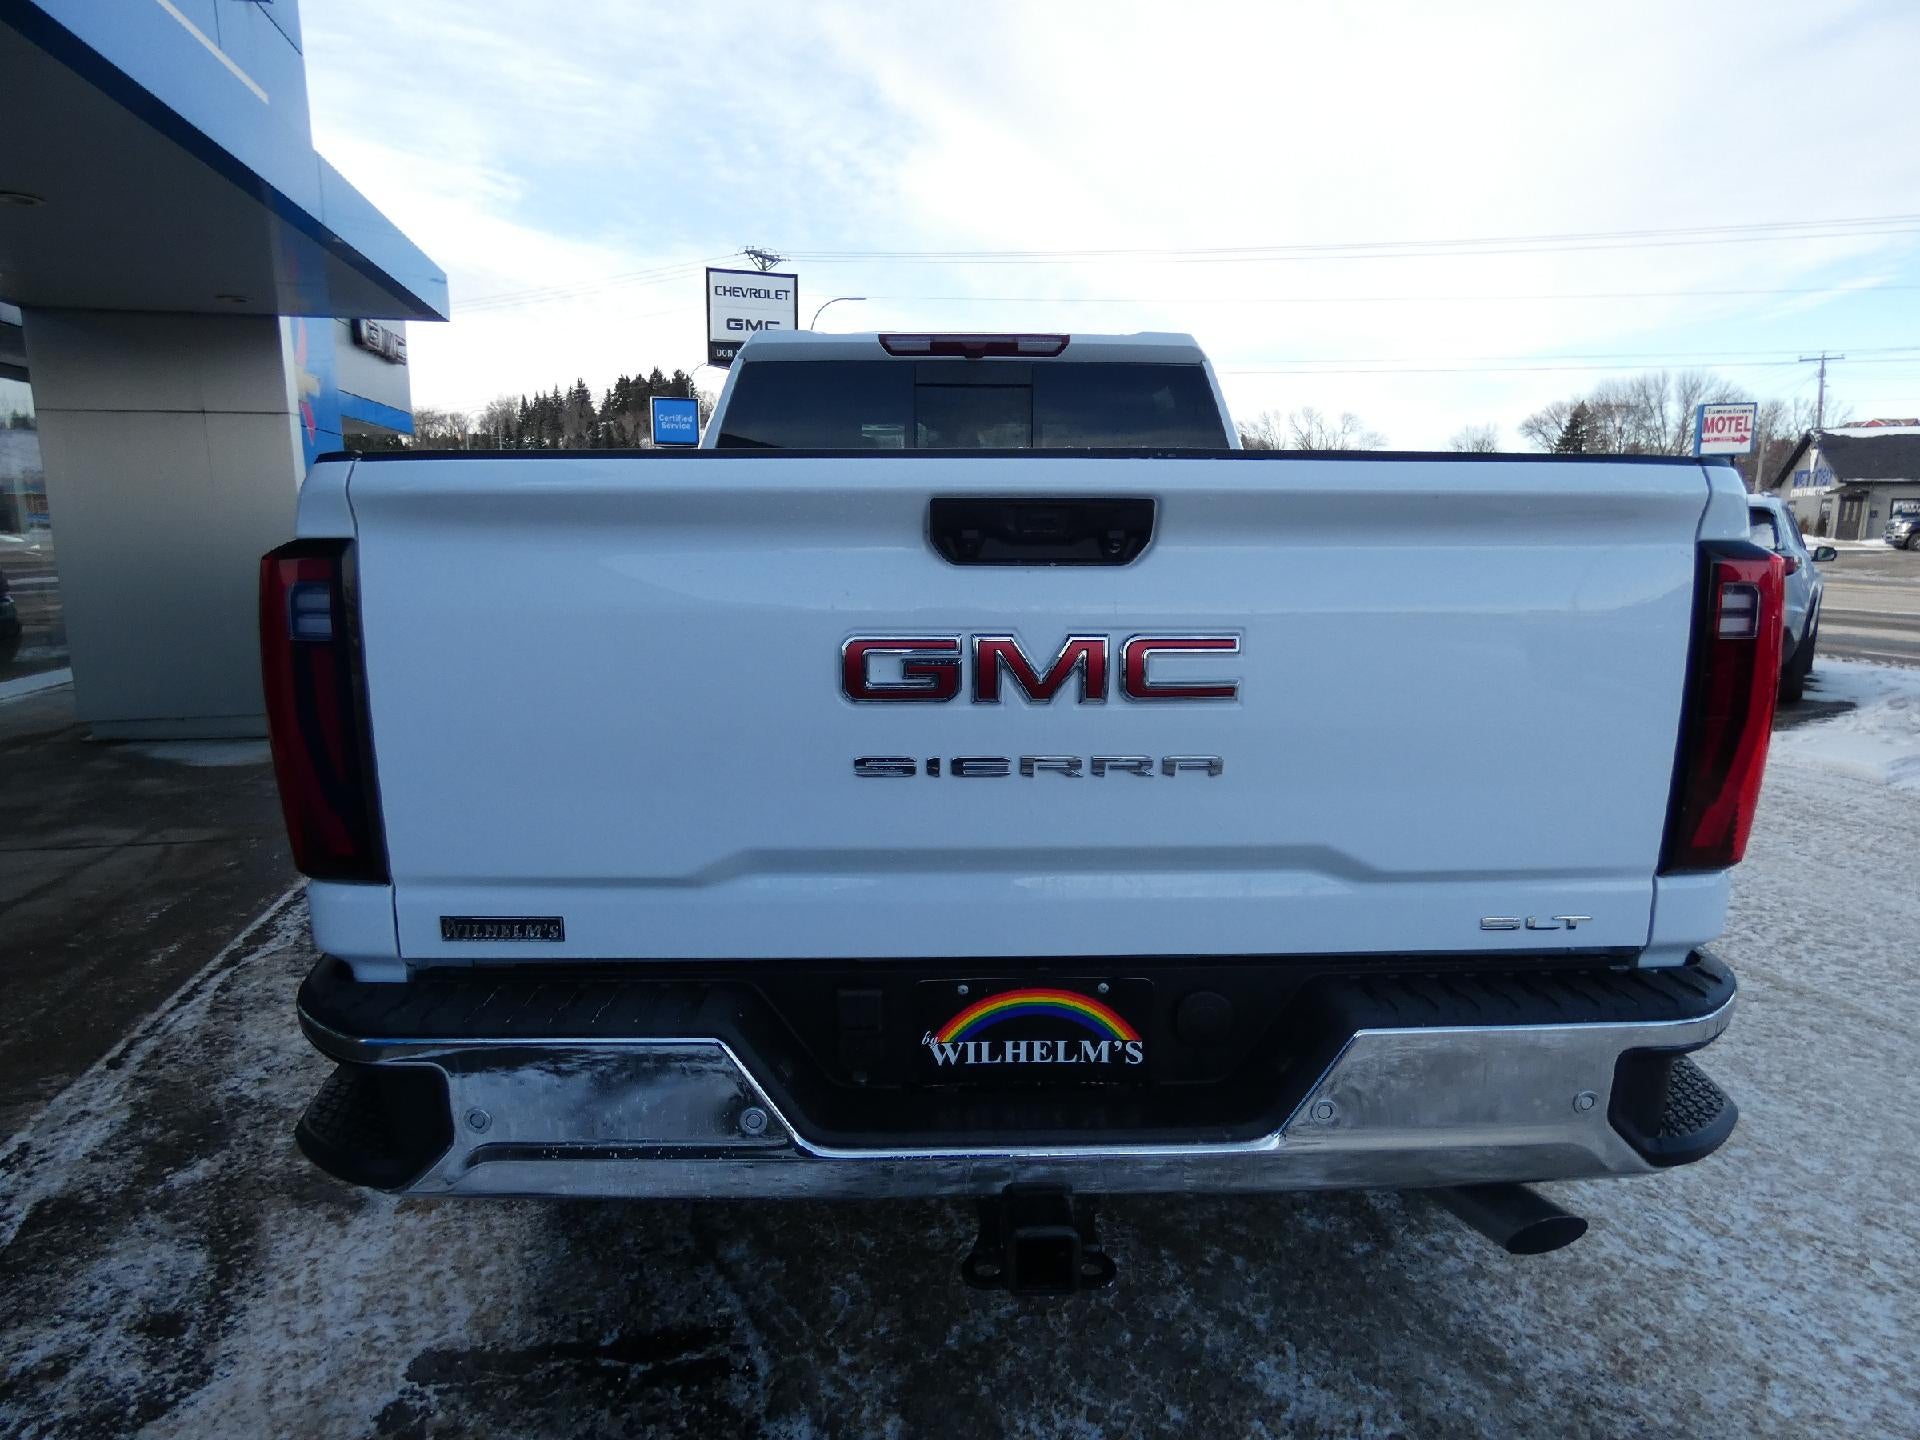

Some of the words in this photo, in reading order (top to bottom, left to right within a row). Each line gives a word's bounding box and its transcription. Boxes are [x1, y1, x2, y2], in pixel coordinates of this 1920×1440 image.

[714, 285, 790, 300] CHEVROLET
[726, 318, 780, 331] GMC
[659, 414, 693, 422] Certified
[1703, 416, 1751, 433] MOTEL
[661, 422, 691, 430] Service
[840, 632, 1241, 704] GMC
[853, 755, 1224, 778] SIERRA
[1480, 915, 1593, 930] SLT
[921, 1031, 939, 1046] by
[931, 1040, 1144, 1066] WILHELM'S
